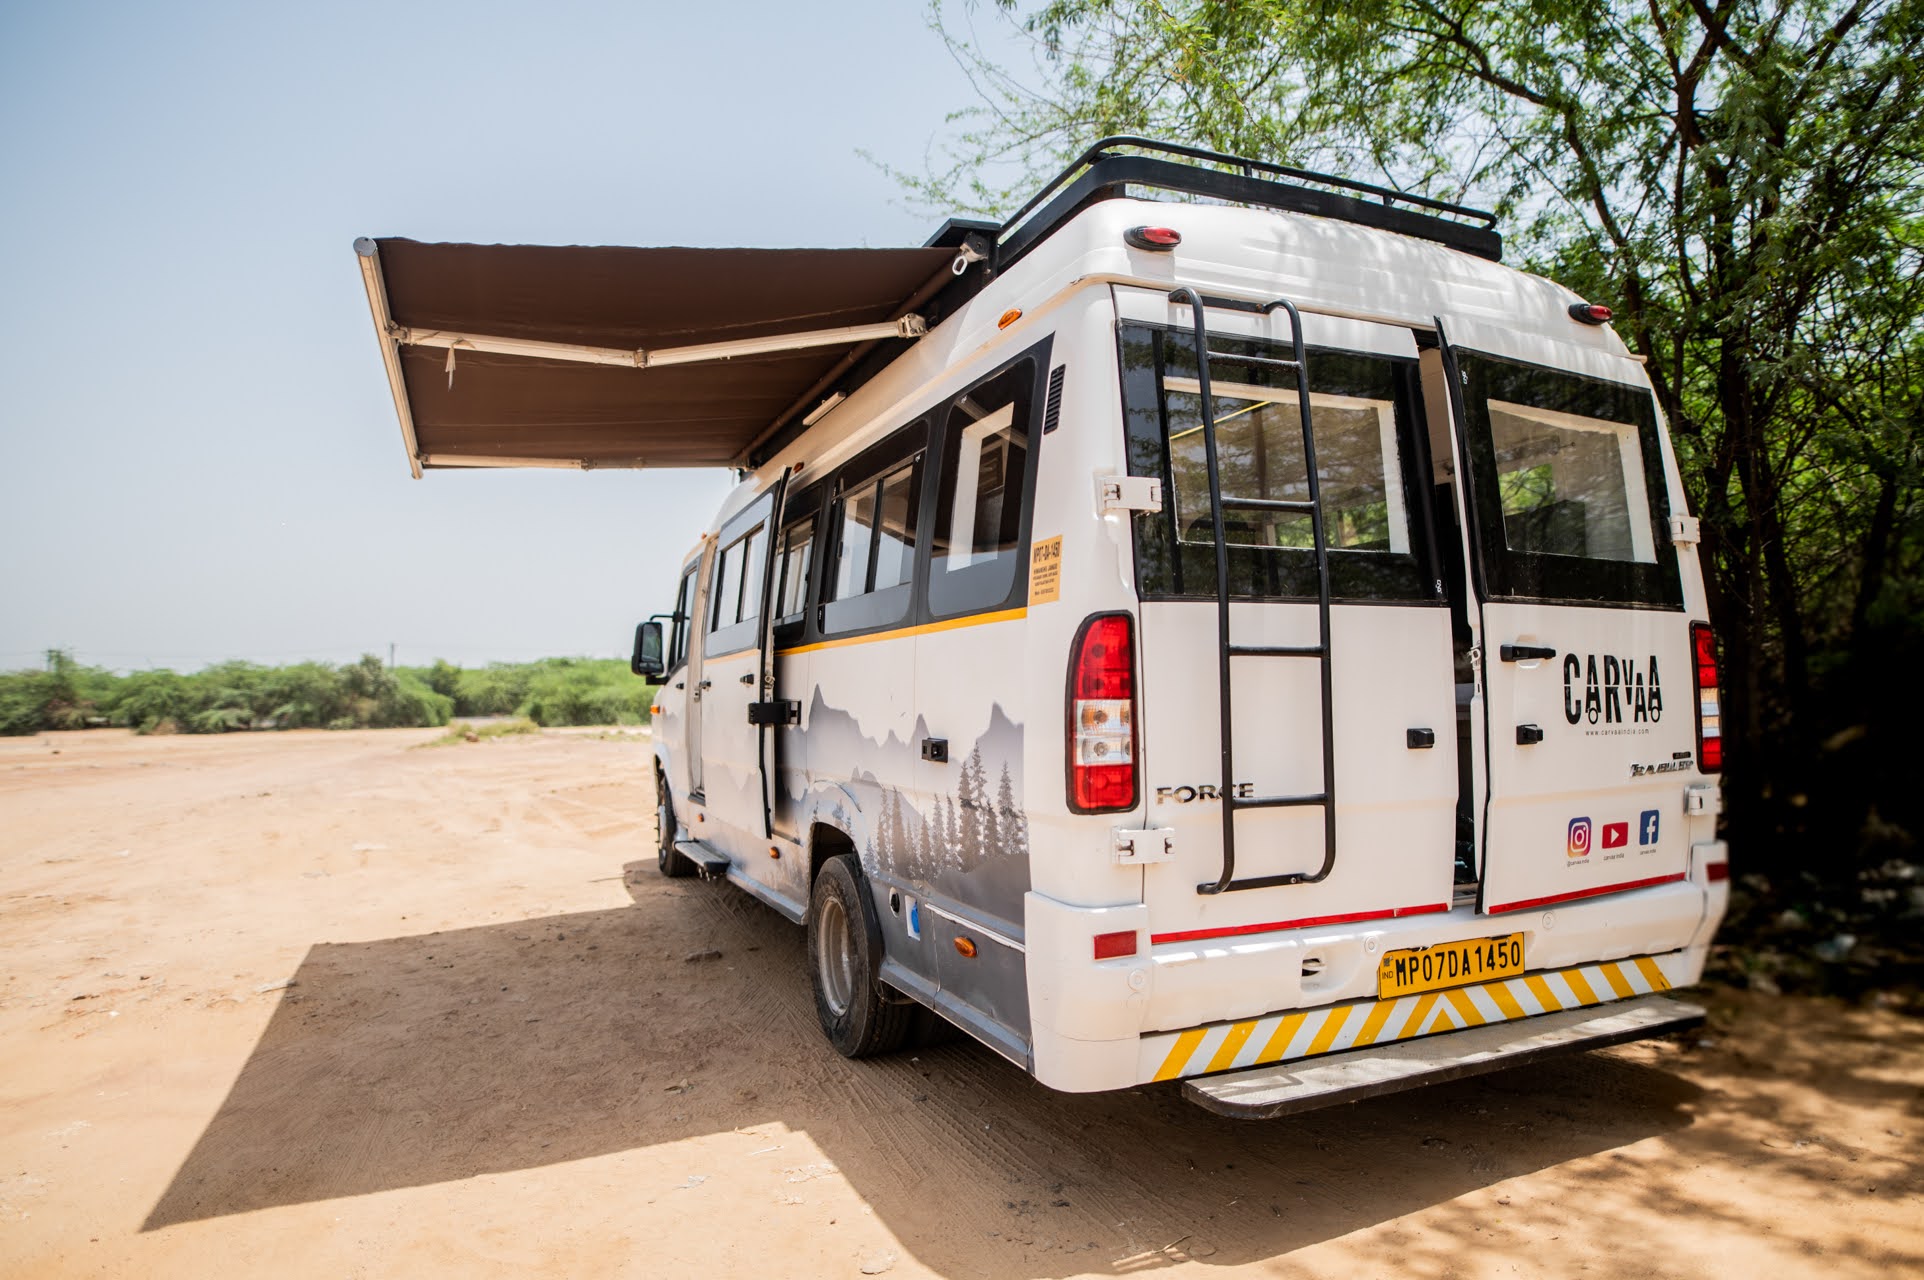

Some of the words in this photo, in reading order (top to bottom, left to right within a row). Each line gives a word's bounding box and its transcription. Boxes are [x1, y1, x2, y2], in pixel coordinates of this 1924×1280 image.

[1563, 653, 1663, 725] CARVAA
[1382, 970, 1394, 980] IND
[1395, 940, 1520, 987] MP07DA1450
